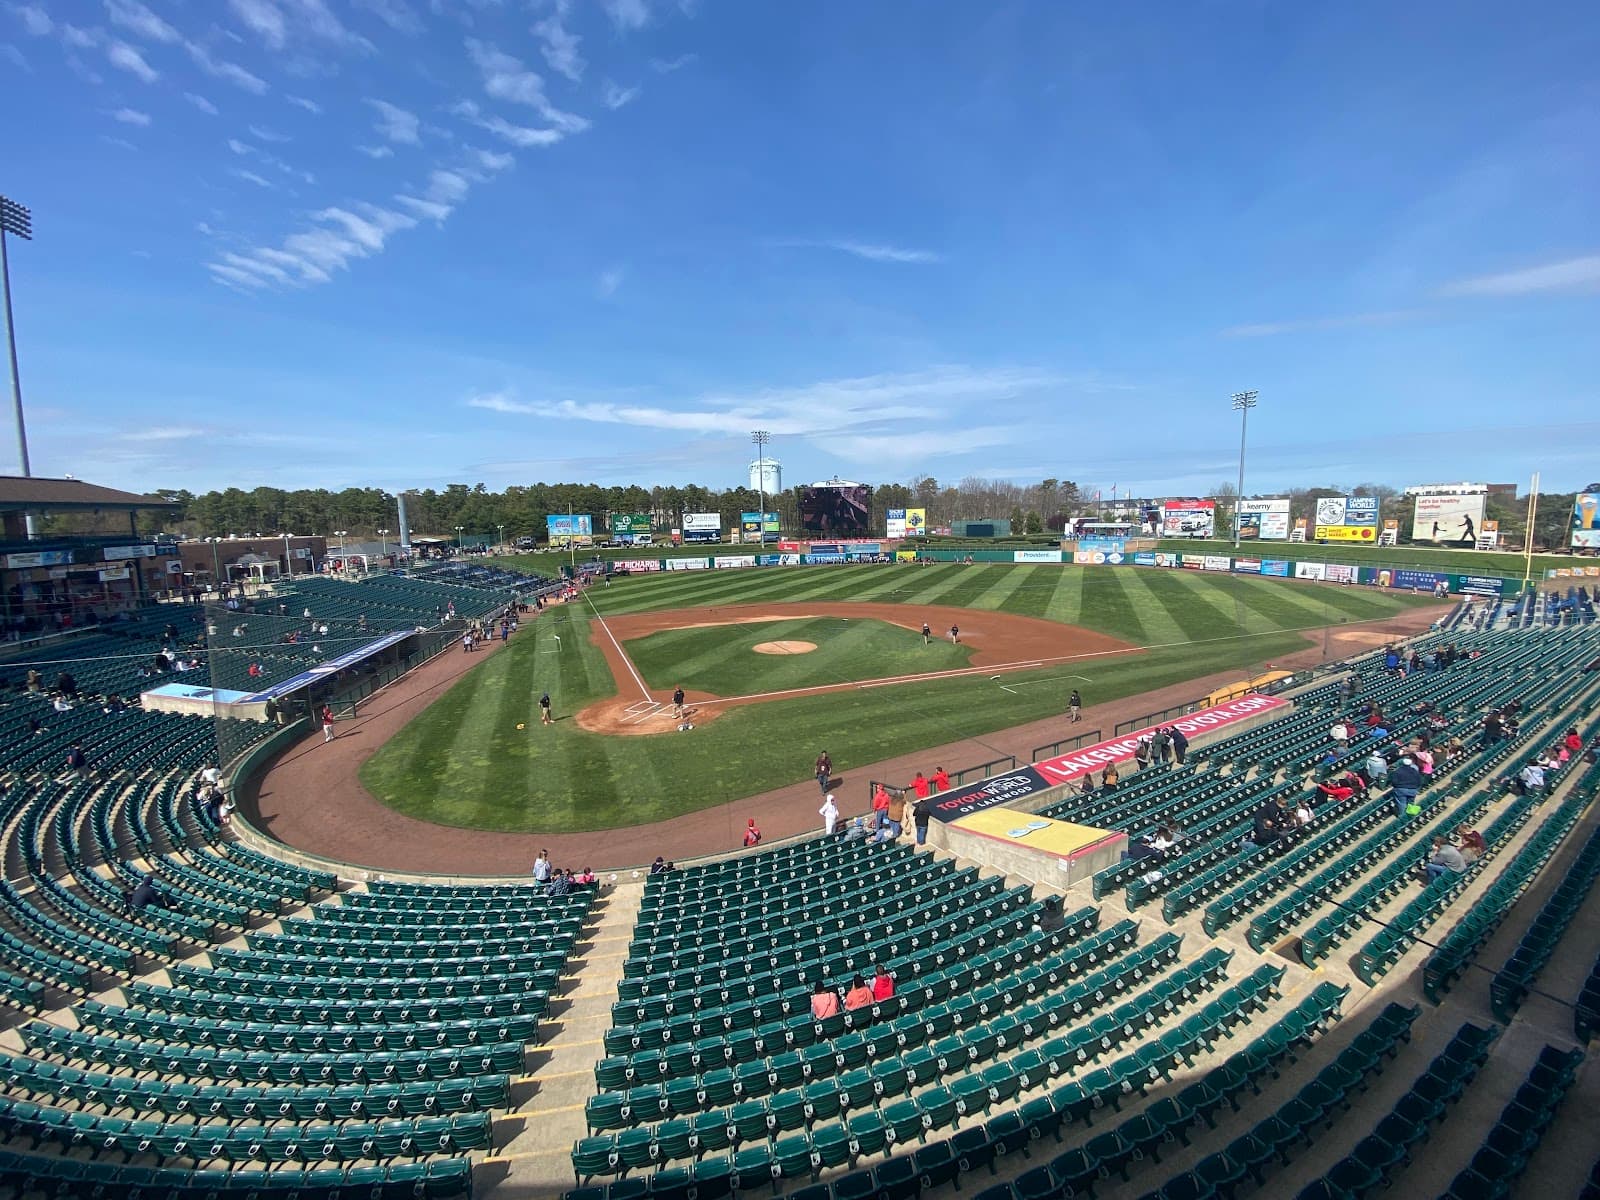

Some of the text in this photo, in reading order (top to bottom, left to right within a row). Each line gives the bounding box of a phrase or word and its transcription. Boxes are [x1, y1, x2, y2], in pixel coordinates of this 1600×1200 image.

[1247, 503, 1271, 511] kearny
[1046, 698, 1276, 776] LAKEWOOYOTA.COM
[937, 791, 989, 811] TOYOTA
[960, 787, 1033, 813] OF LAKEWOOD
